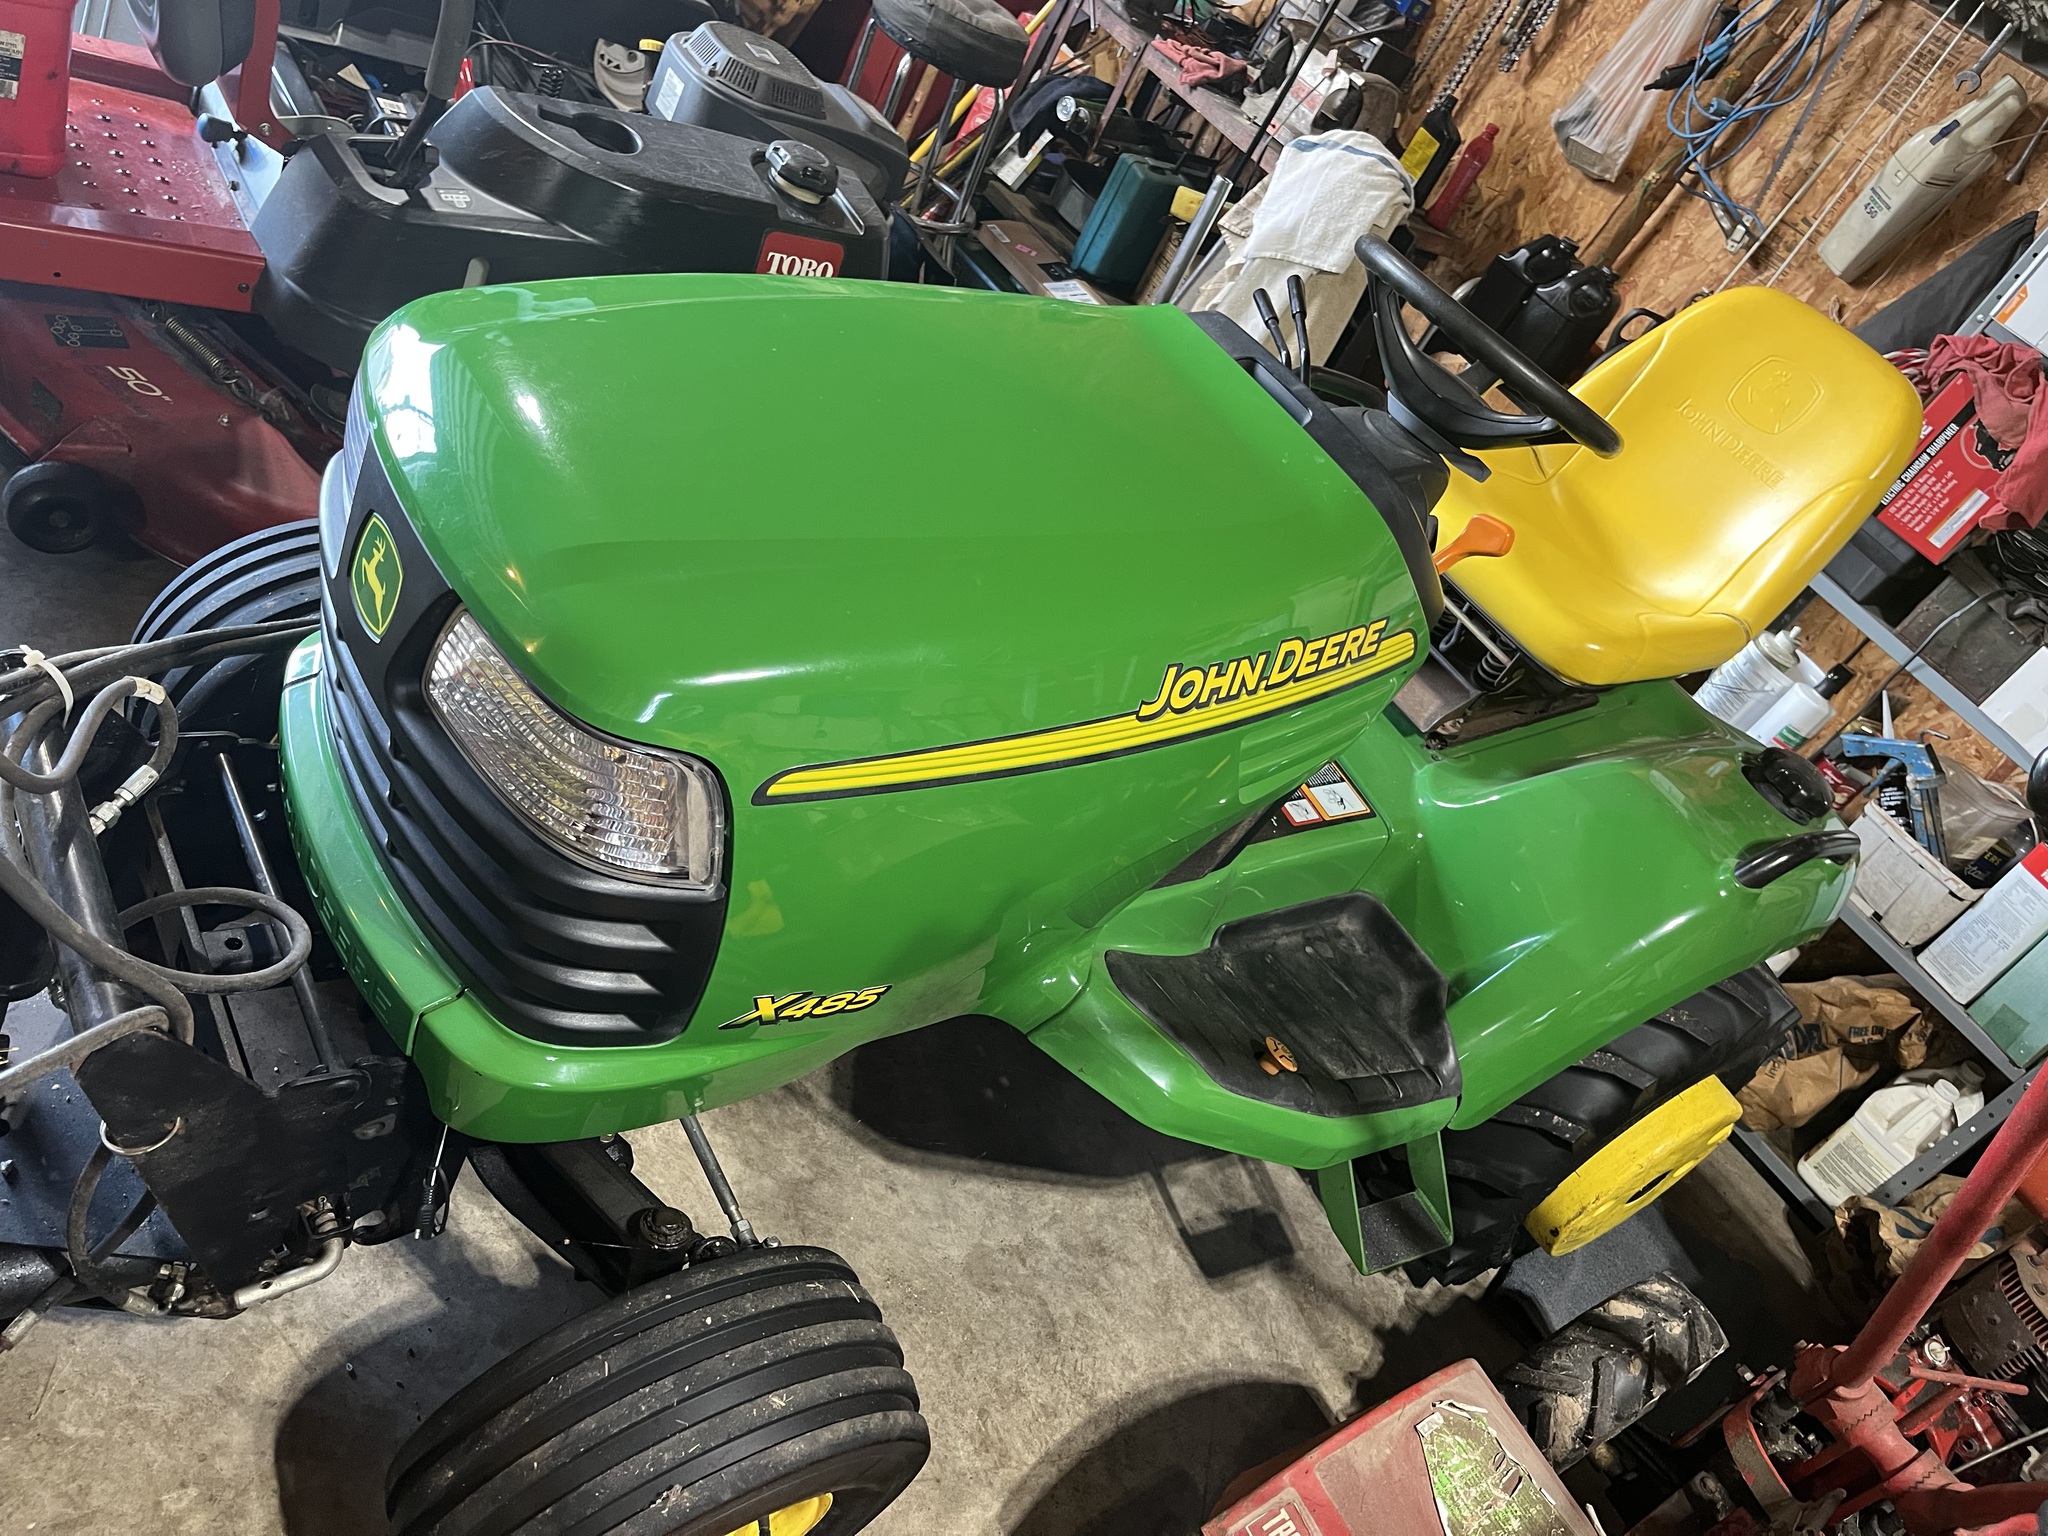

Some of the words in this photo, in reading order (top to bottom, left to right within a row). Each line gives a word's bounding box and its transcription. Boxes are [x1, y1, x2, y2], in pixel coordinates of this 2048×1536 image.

[1863, 202, 1878, 219] 450
[766, 251, 834, 278] TORO
[1675, 397, 1725, 443] JOHN
[1719, 432, 1785, 491] DEERE
[1881, 479, 1905, 505] ELECTRIC
[1901, 452, 1931, 483] CHAINSAW
[1926, 422, 1960, 456] SHARPENER
[1136, 652, 1270, 721] JOHN
[1264, 617, 1390, 690] DEERE
[303, 848, 392, 1025] DEERE
[719, 985, 892, 1030] X485
